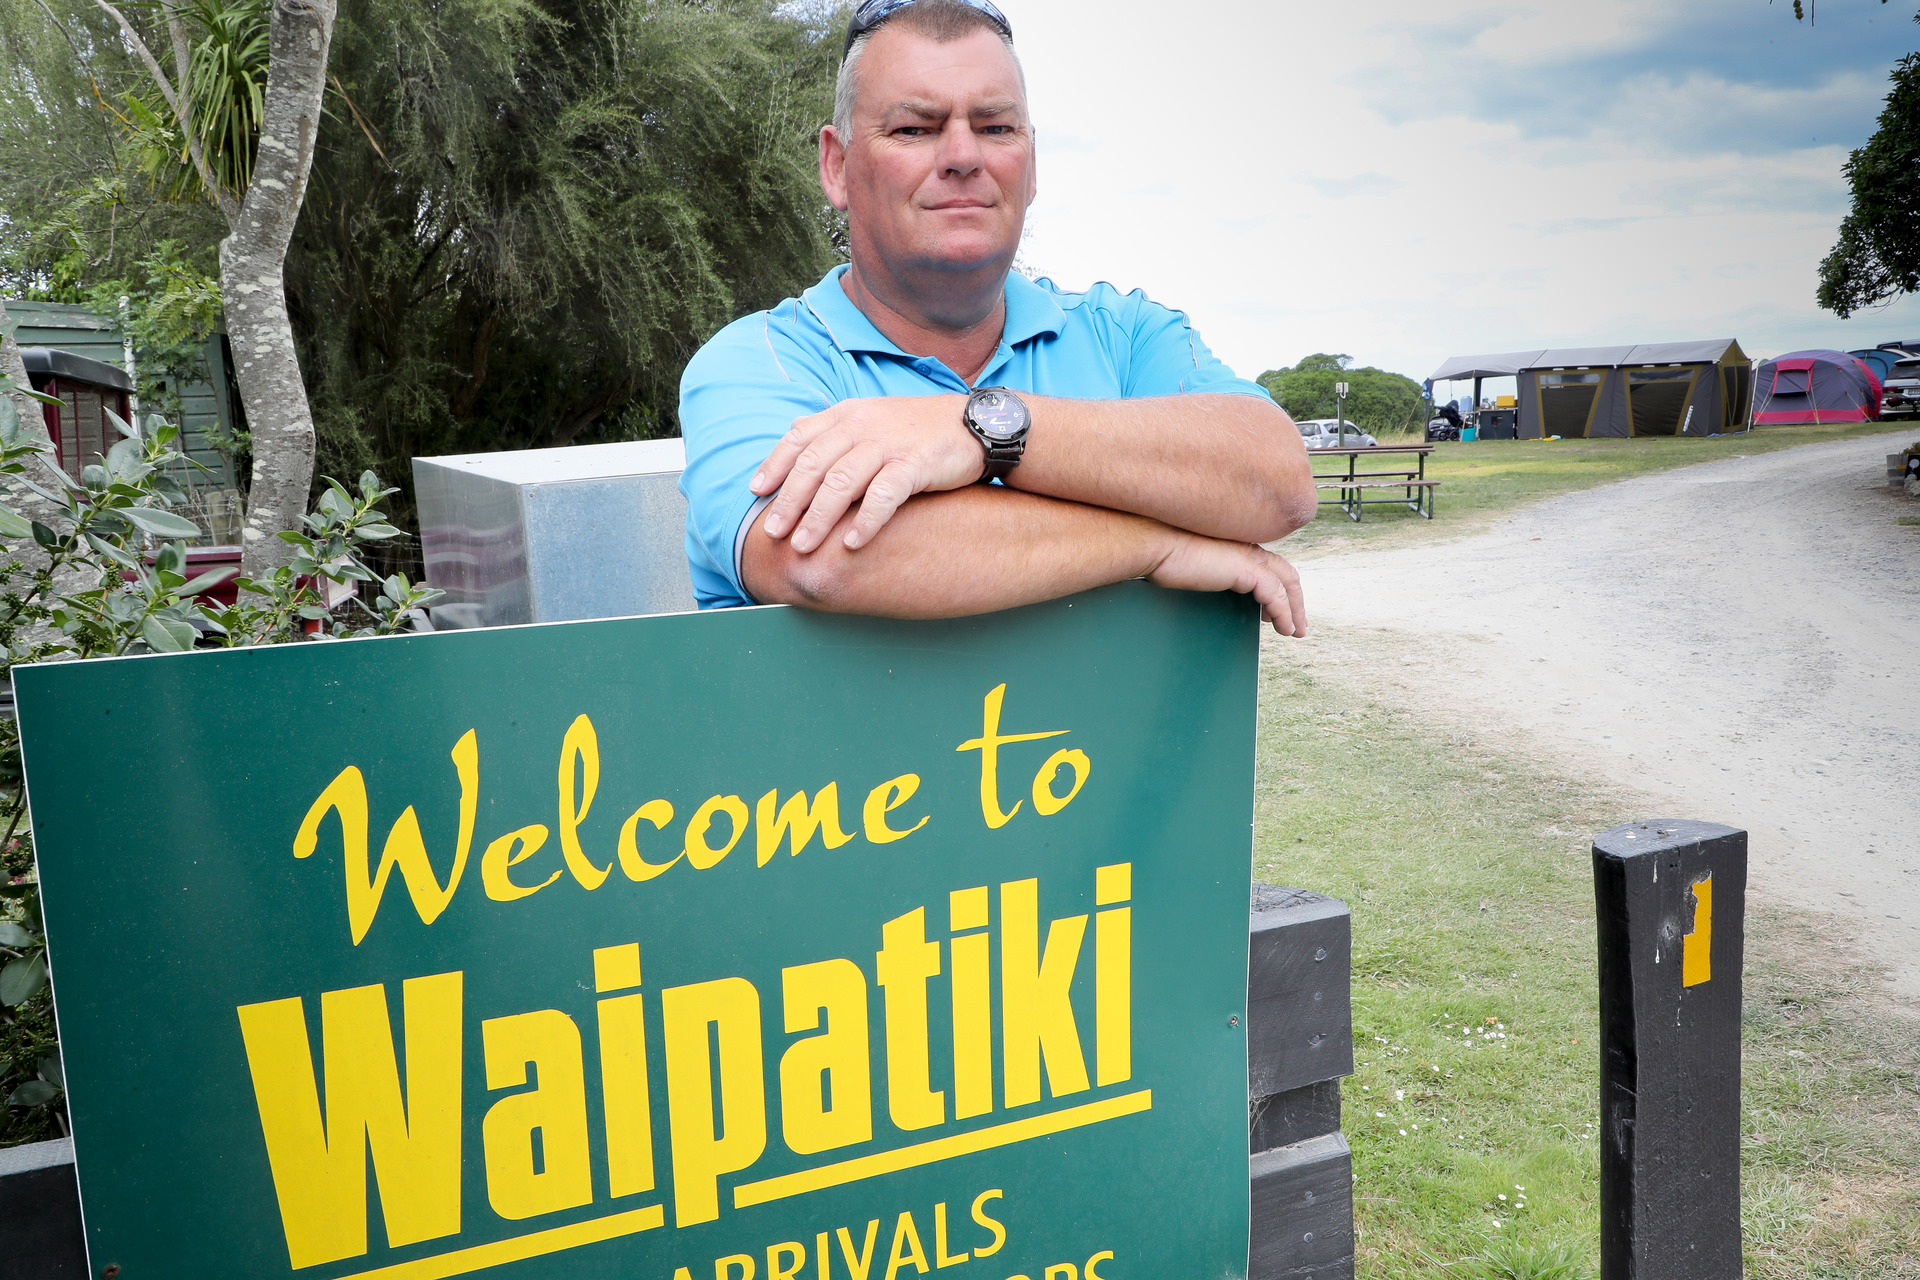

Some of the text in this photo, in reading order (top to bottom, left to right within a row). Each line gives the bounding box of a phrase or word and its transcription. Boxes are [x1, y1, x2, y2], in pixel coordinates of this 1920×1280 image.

[292, 683, 1091, 946] Welcome to
[237, 862, 1132, 1271] Waipatiki
[672, 1188, 1007, 1280] RIVALS
